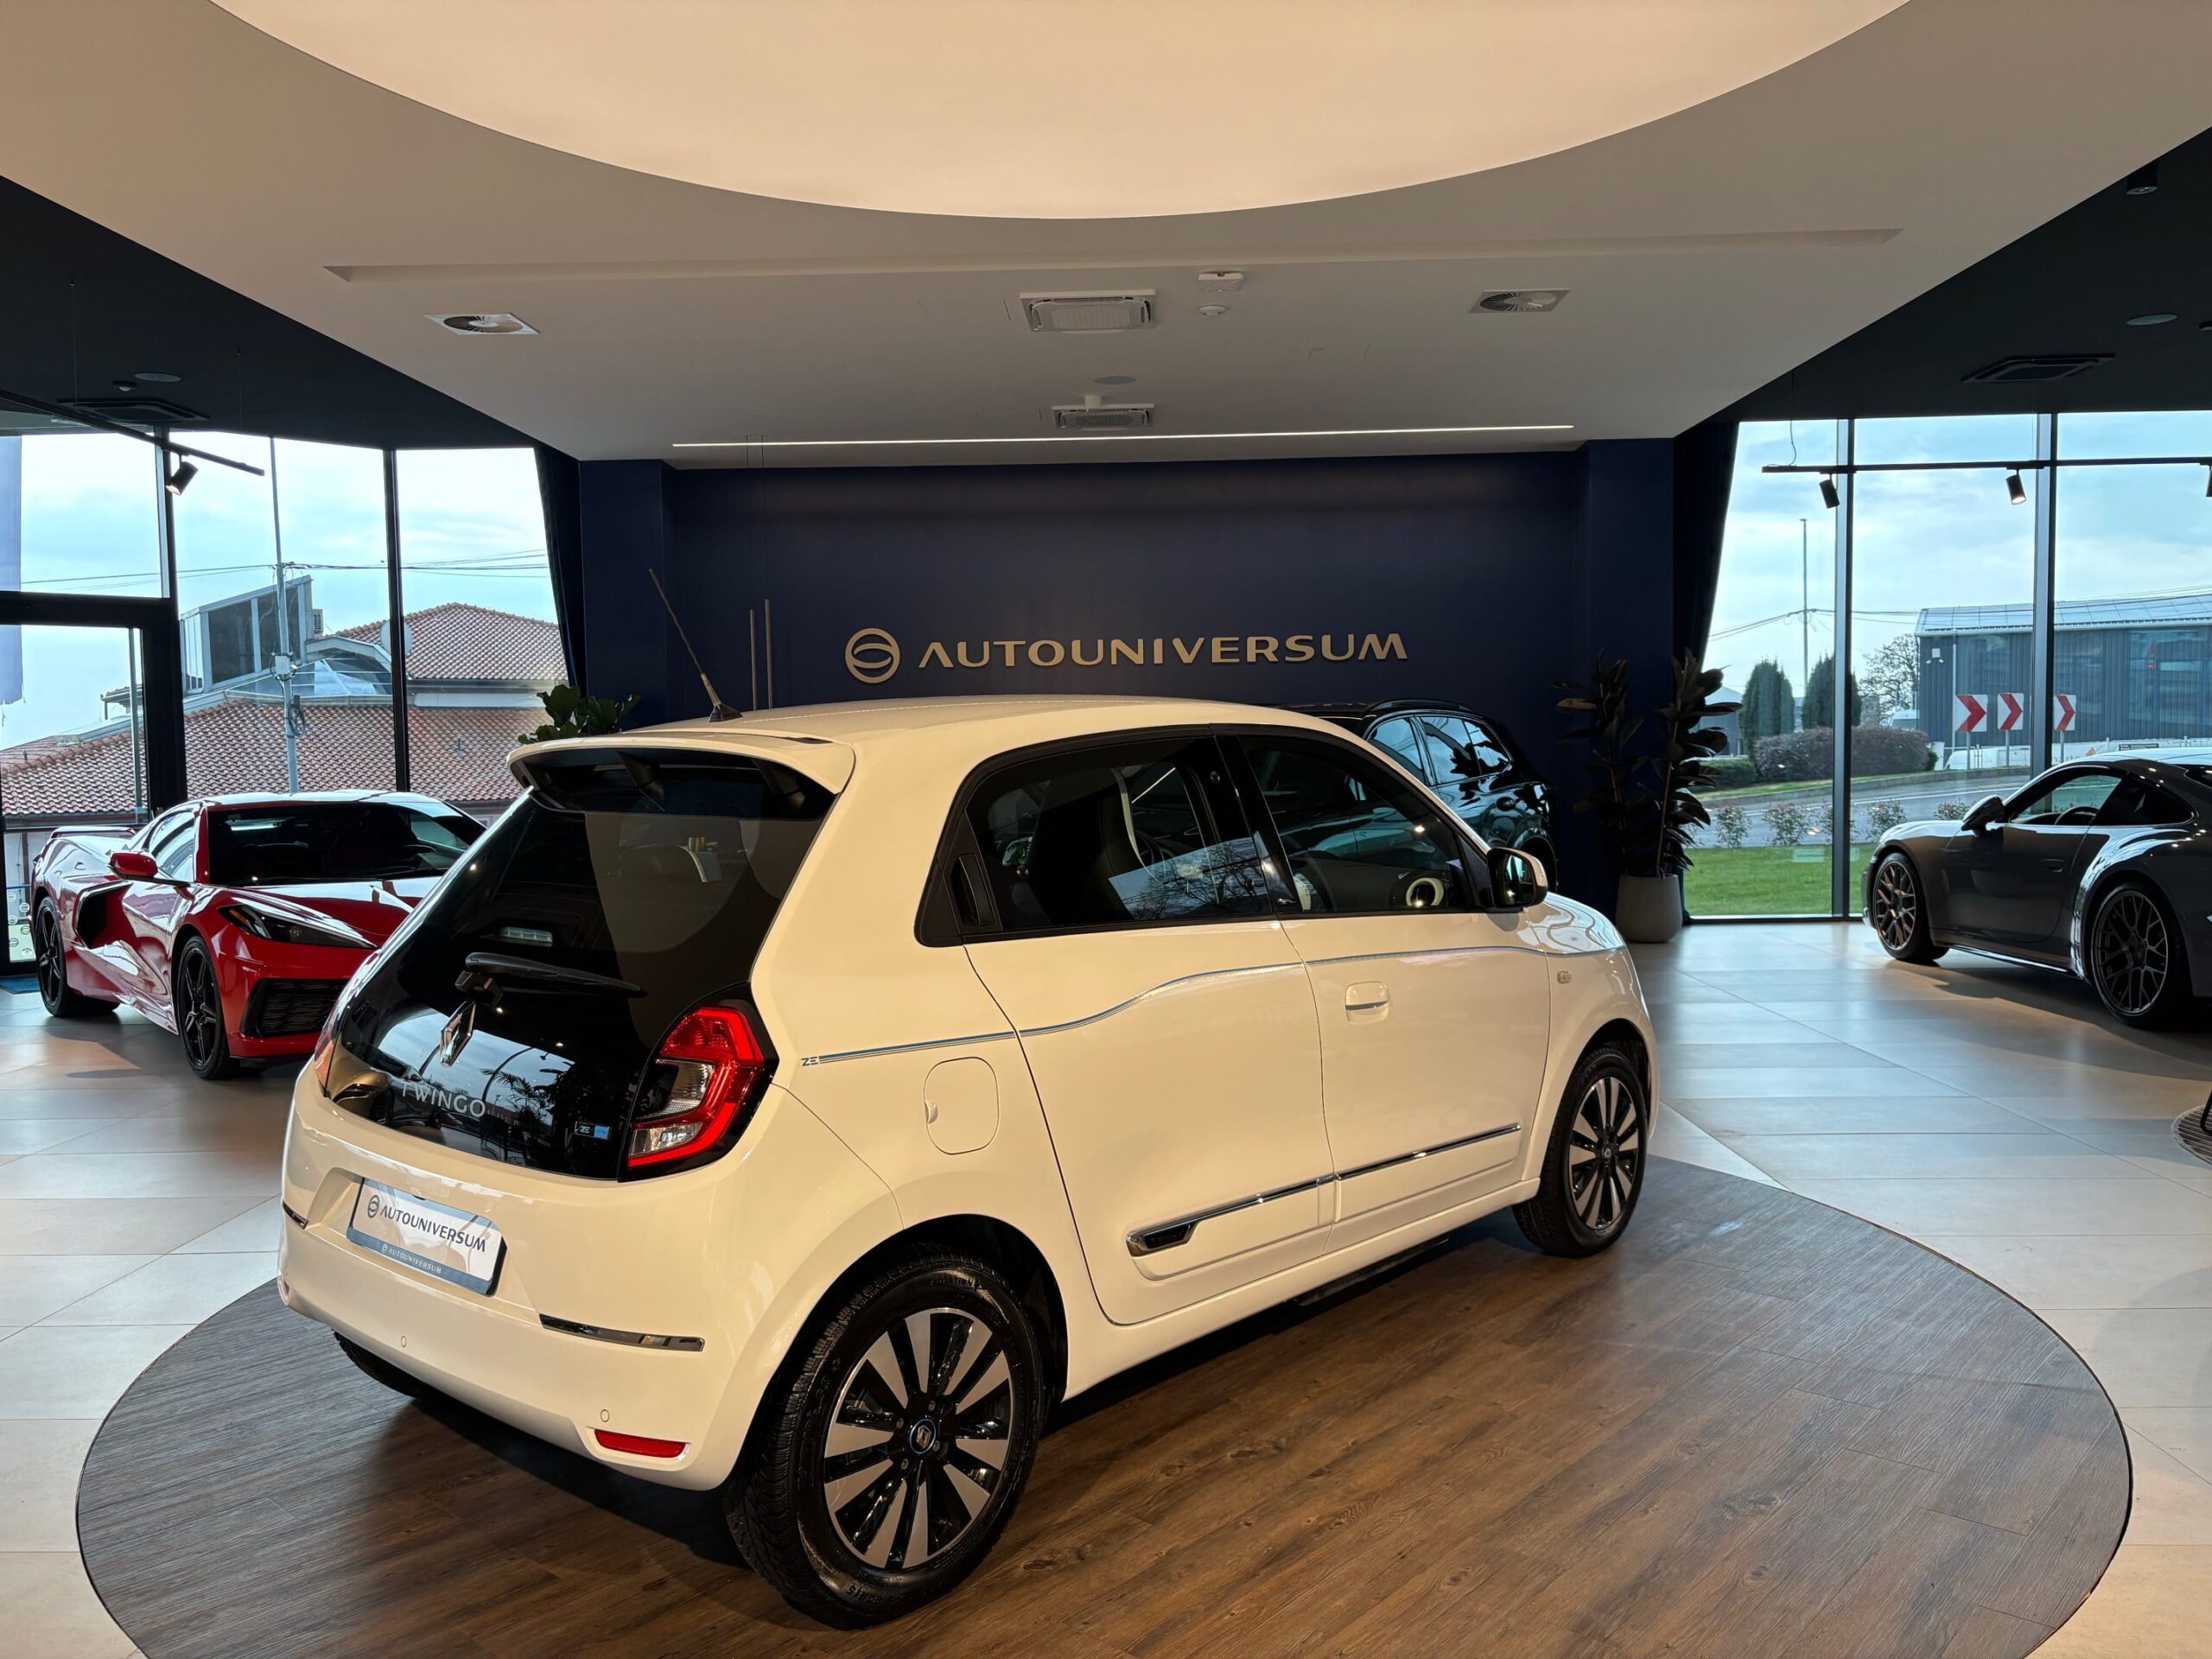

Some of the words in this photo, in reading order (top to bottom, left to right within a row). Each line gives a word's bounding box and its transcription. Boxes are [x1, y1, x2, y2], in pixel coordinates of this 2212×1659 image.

[918, 632, 1408, 669] AUTOUNIVERSUM
[401, 1082, 486, 1117] TWINGO
[380, 1206, 486, 1252] AUTOUNIVERSUM
[389, 1248, 442, 1274] AUTOUNIVERSUM
